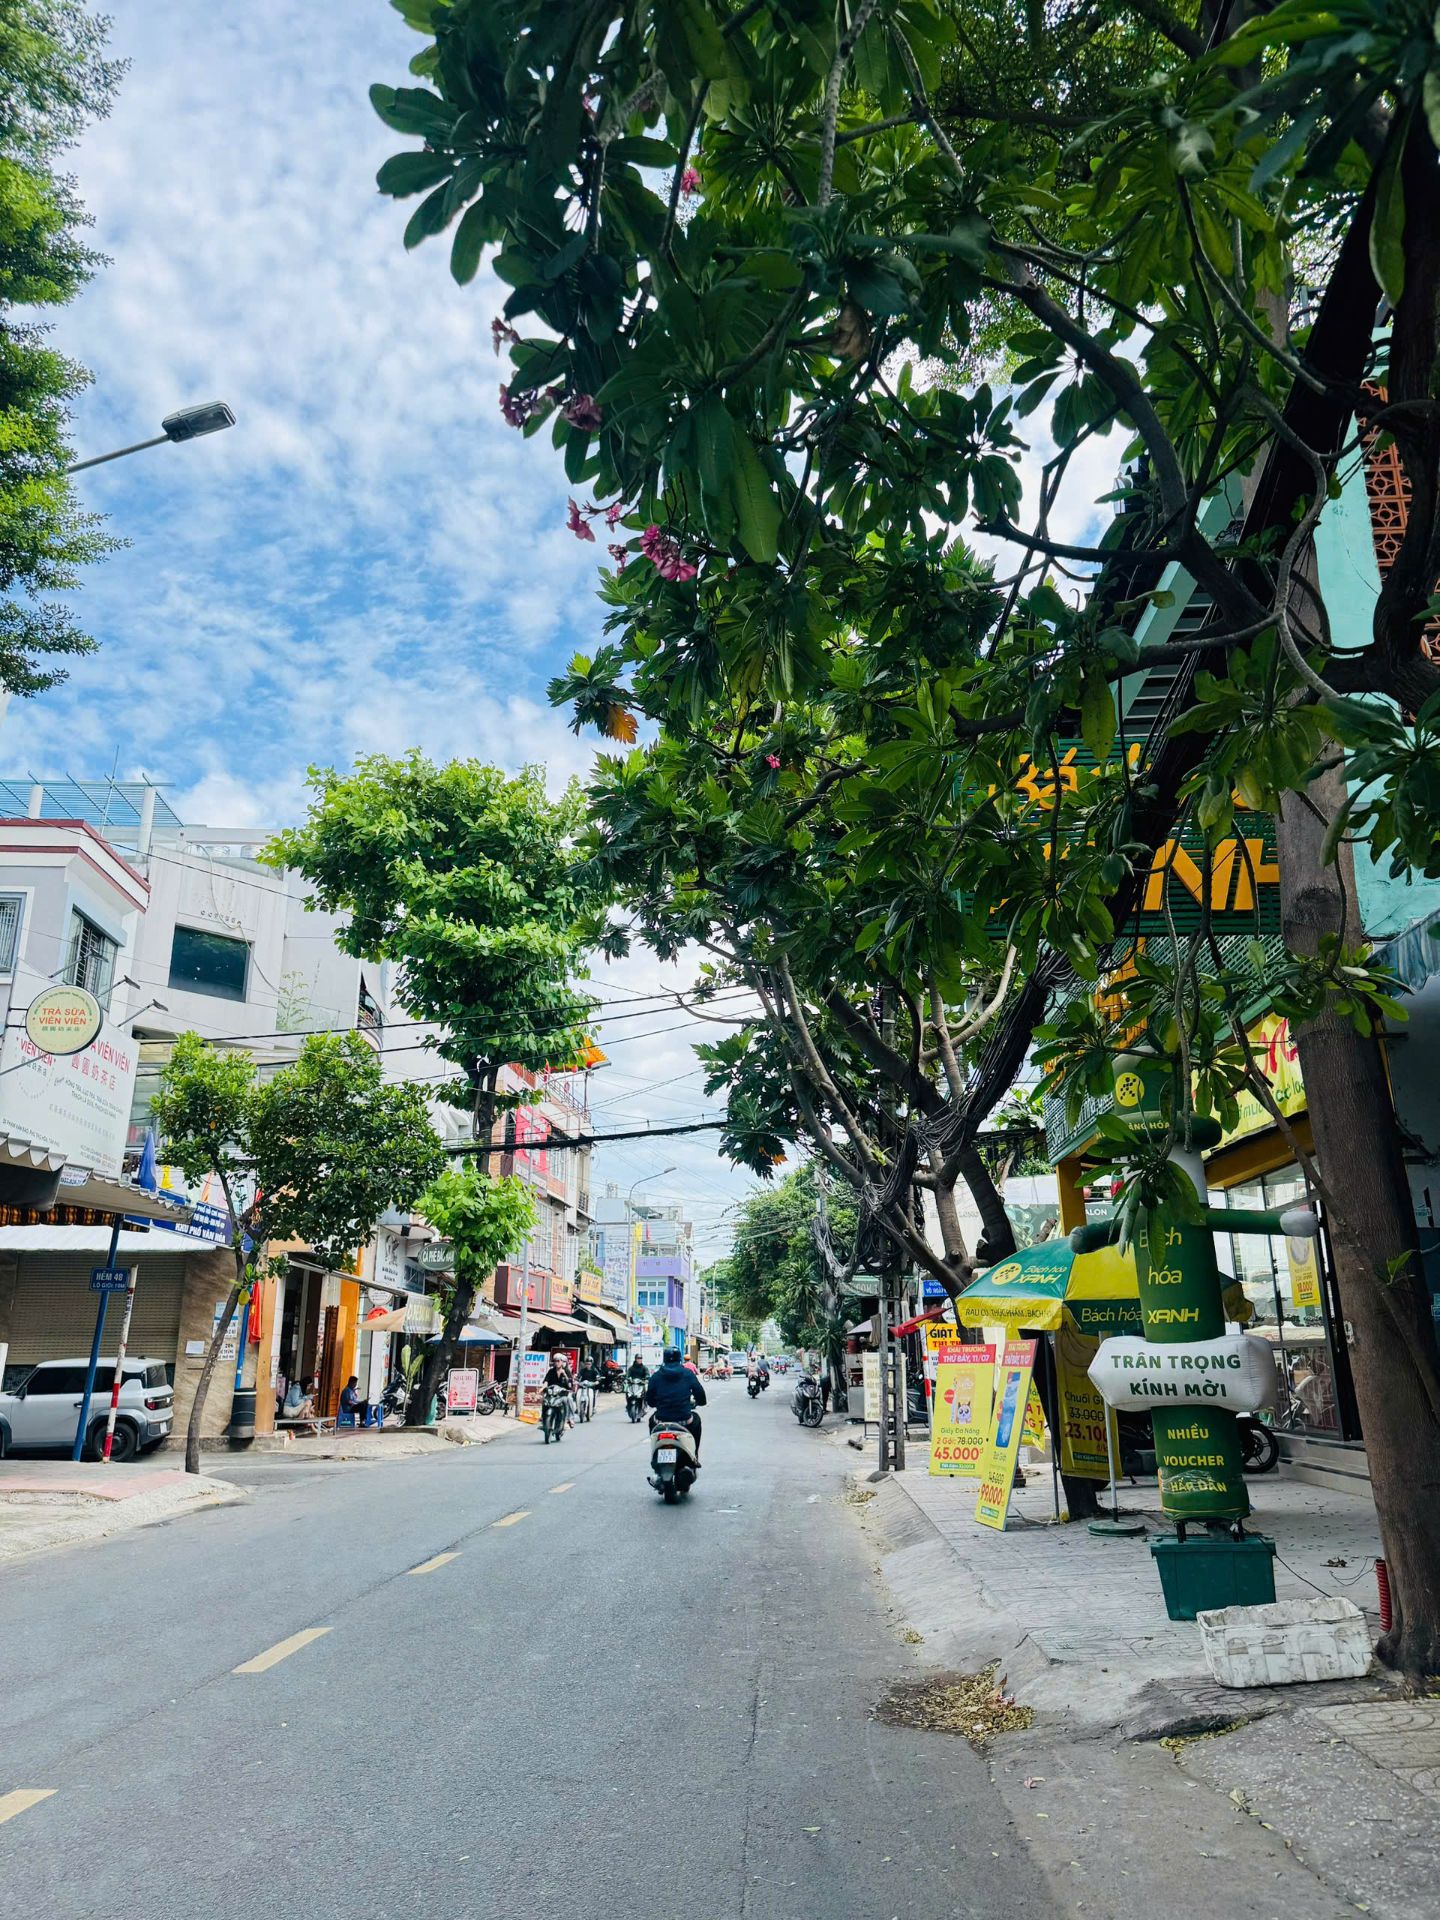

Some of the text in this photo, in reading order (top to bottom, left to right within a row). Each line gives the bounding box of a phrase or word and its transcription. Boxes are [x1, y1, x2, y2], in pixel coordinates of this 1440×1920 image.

[189, 1224, 202, 1238] PHỐ
[1024, 1265, 1068, 1273] Bách hóa
[1148, 1264, 1183, 1285] hóa
[1013, 1273, 1061, 1284] XANH
[1081, 1306, 1143, 1322] Bách hóa
[1147, 1307, 1200, 1324] XANH
[1111, 1351, 1241, 1374] TRÂN TRỌNG
[1130, 1378, 1227, 1397] KÍNH MỜI
[1064, 1391, 1091, 1405] Chuối
[1167, 1423, 1209, 1440] NHIỀU
[1163, 1455, 1225, 1466] VOUCHER
